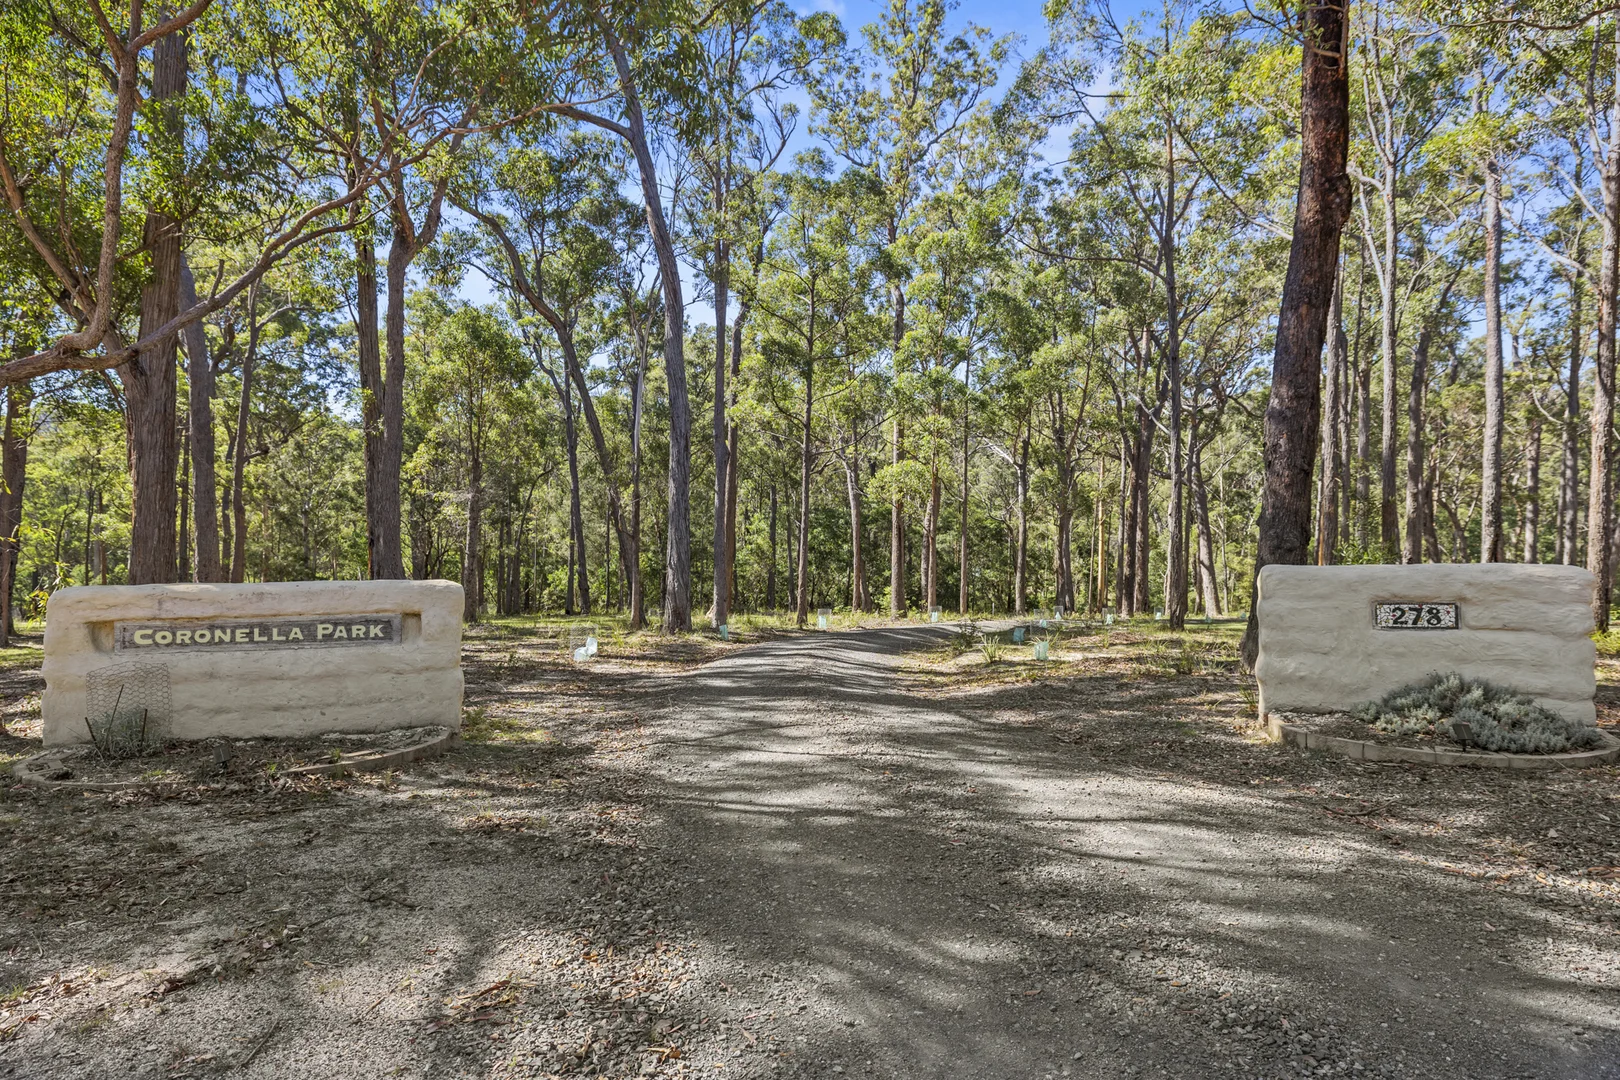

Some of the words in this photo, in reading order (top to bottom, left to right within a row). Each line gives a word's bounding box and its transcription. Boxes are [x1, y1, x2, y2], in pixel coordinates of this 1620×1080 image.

[1392, 606, 1442, 626] 278
[133, 627, 304, 645] CORONELLA
[316, 623, 385, 640] PARK
